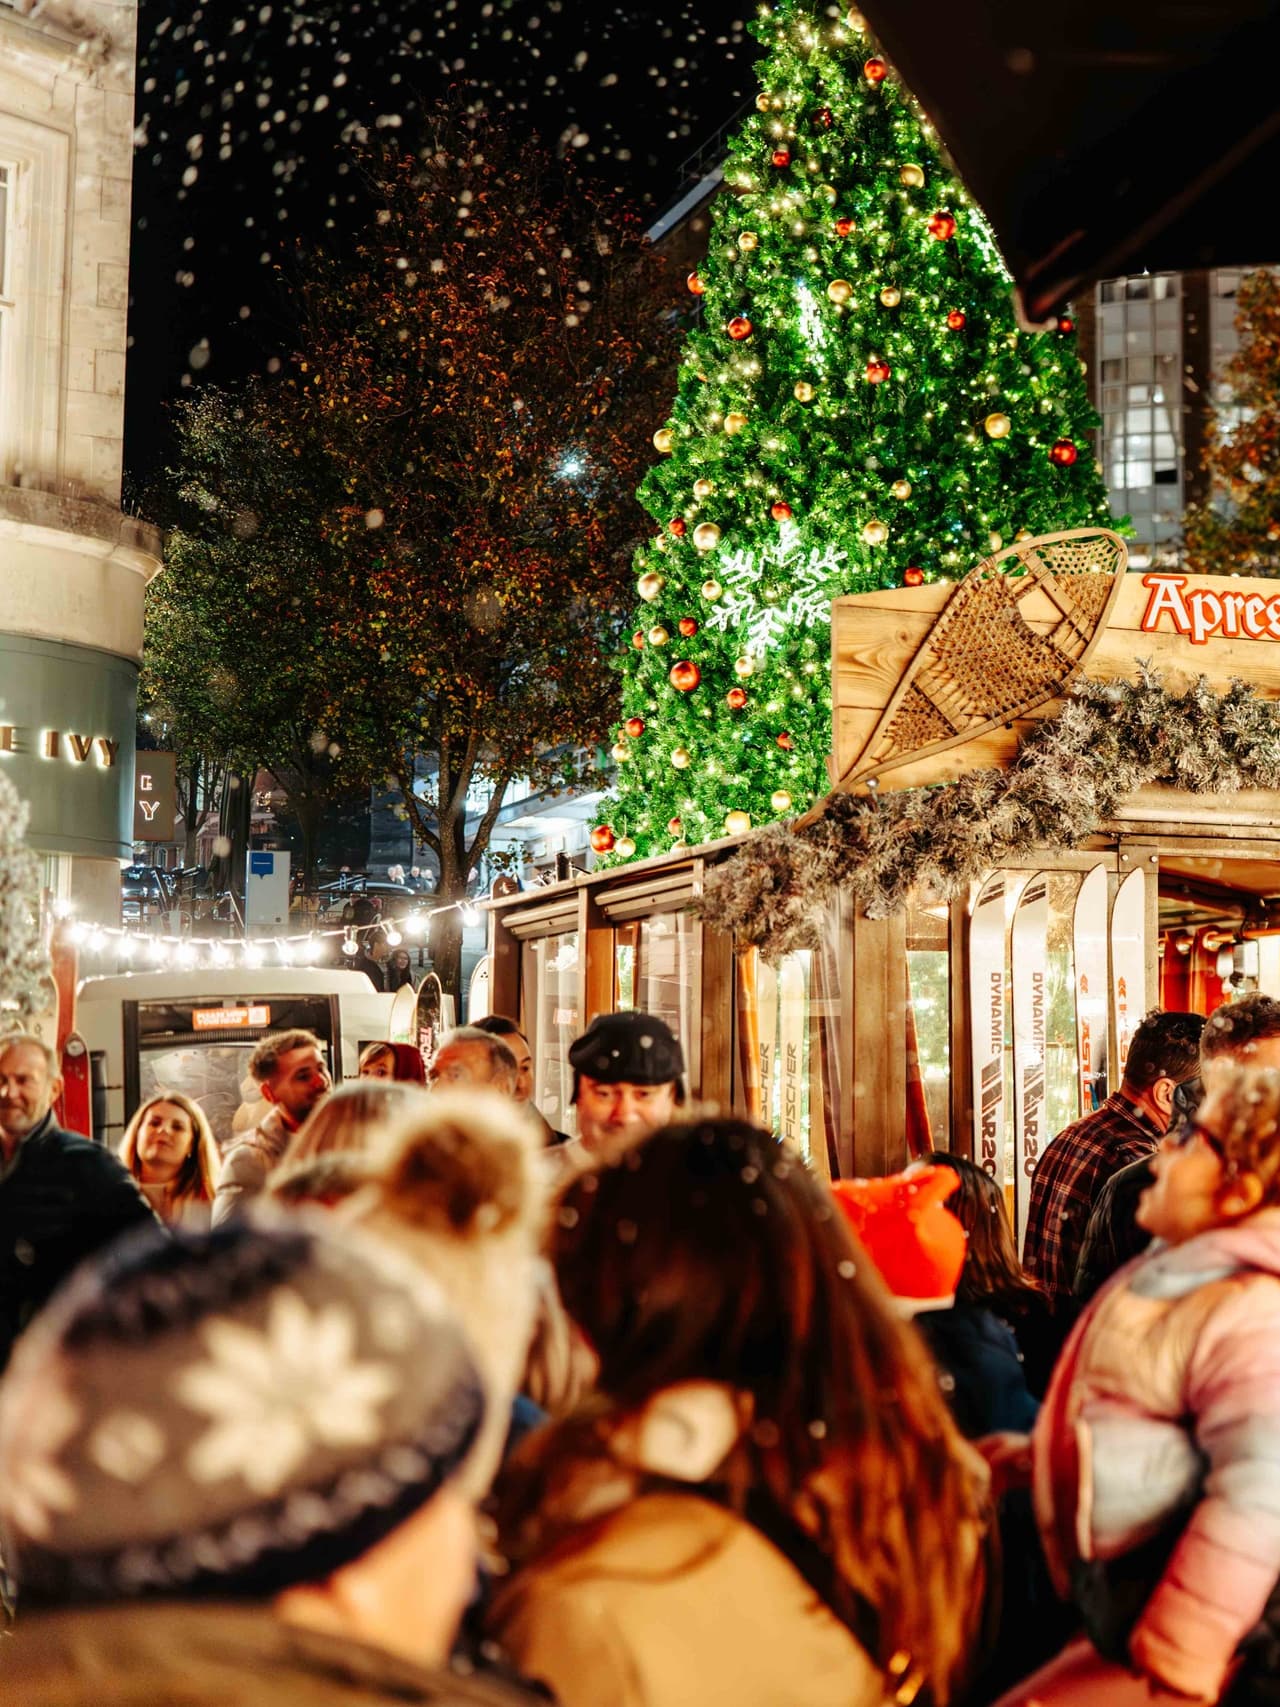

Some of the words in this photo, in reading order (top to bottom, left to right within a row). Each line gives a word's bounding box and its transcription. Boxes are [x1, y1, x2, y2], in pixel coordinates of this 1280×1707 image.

[46, 731, 120, 768] IVY
[139, 800, 160, 821] Y
[991, 972, 1002, 1054] DYNAMIC
[785, 1042, 797, 1140] FISCHER
